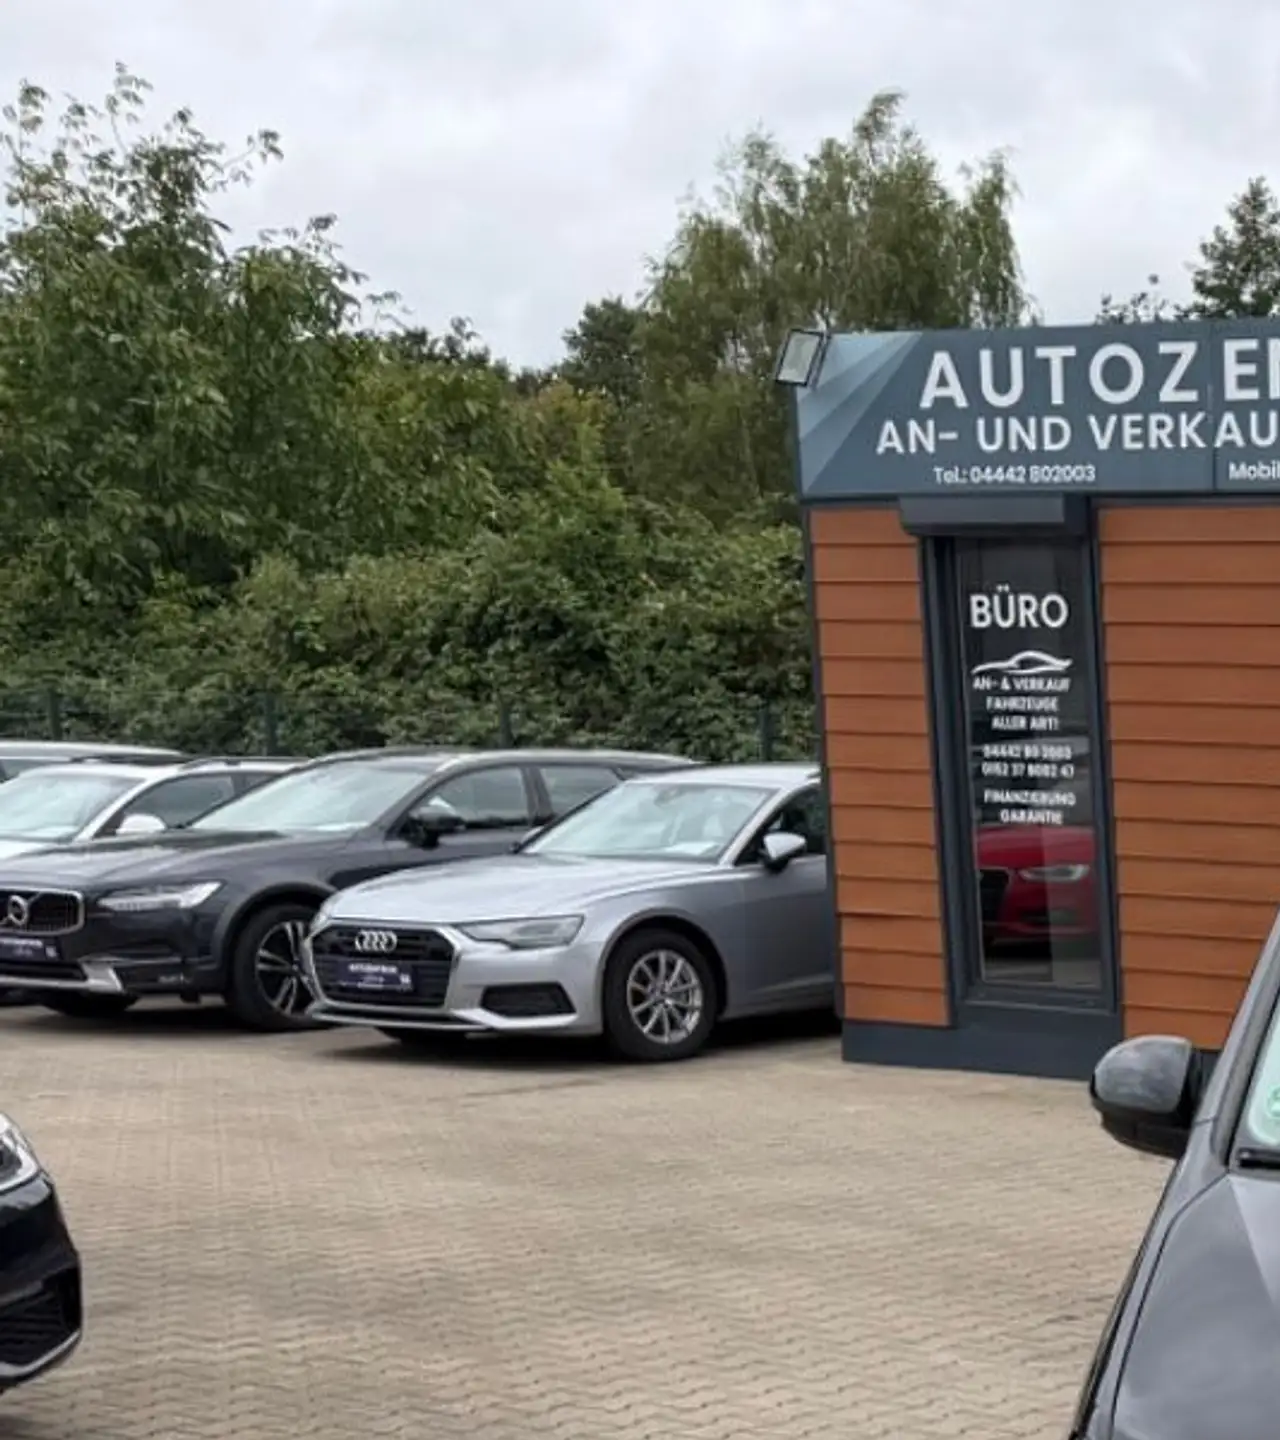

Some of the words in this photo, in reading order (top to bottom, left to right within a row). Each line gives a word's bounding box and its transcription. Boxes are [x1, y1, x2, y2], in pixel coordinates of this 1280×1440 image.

[875, 416, 959, 456] AN-
[976, 414, 1072, 452] UND
[969, 464, 1026, 484] 04442
[969, 583, 1069, 629] BÜRO
